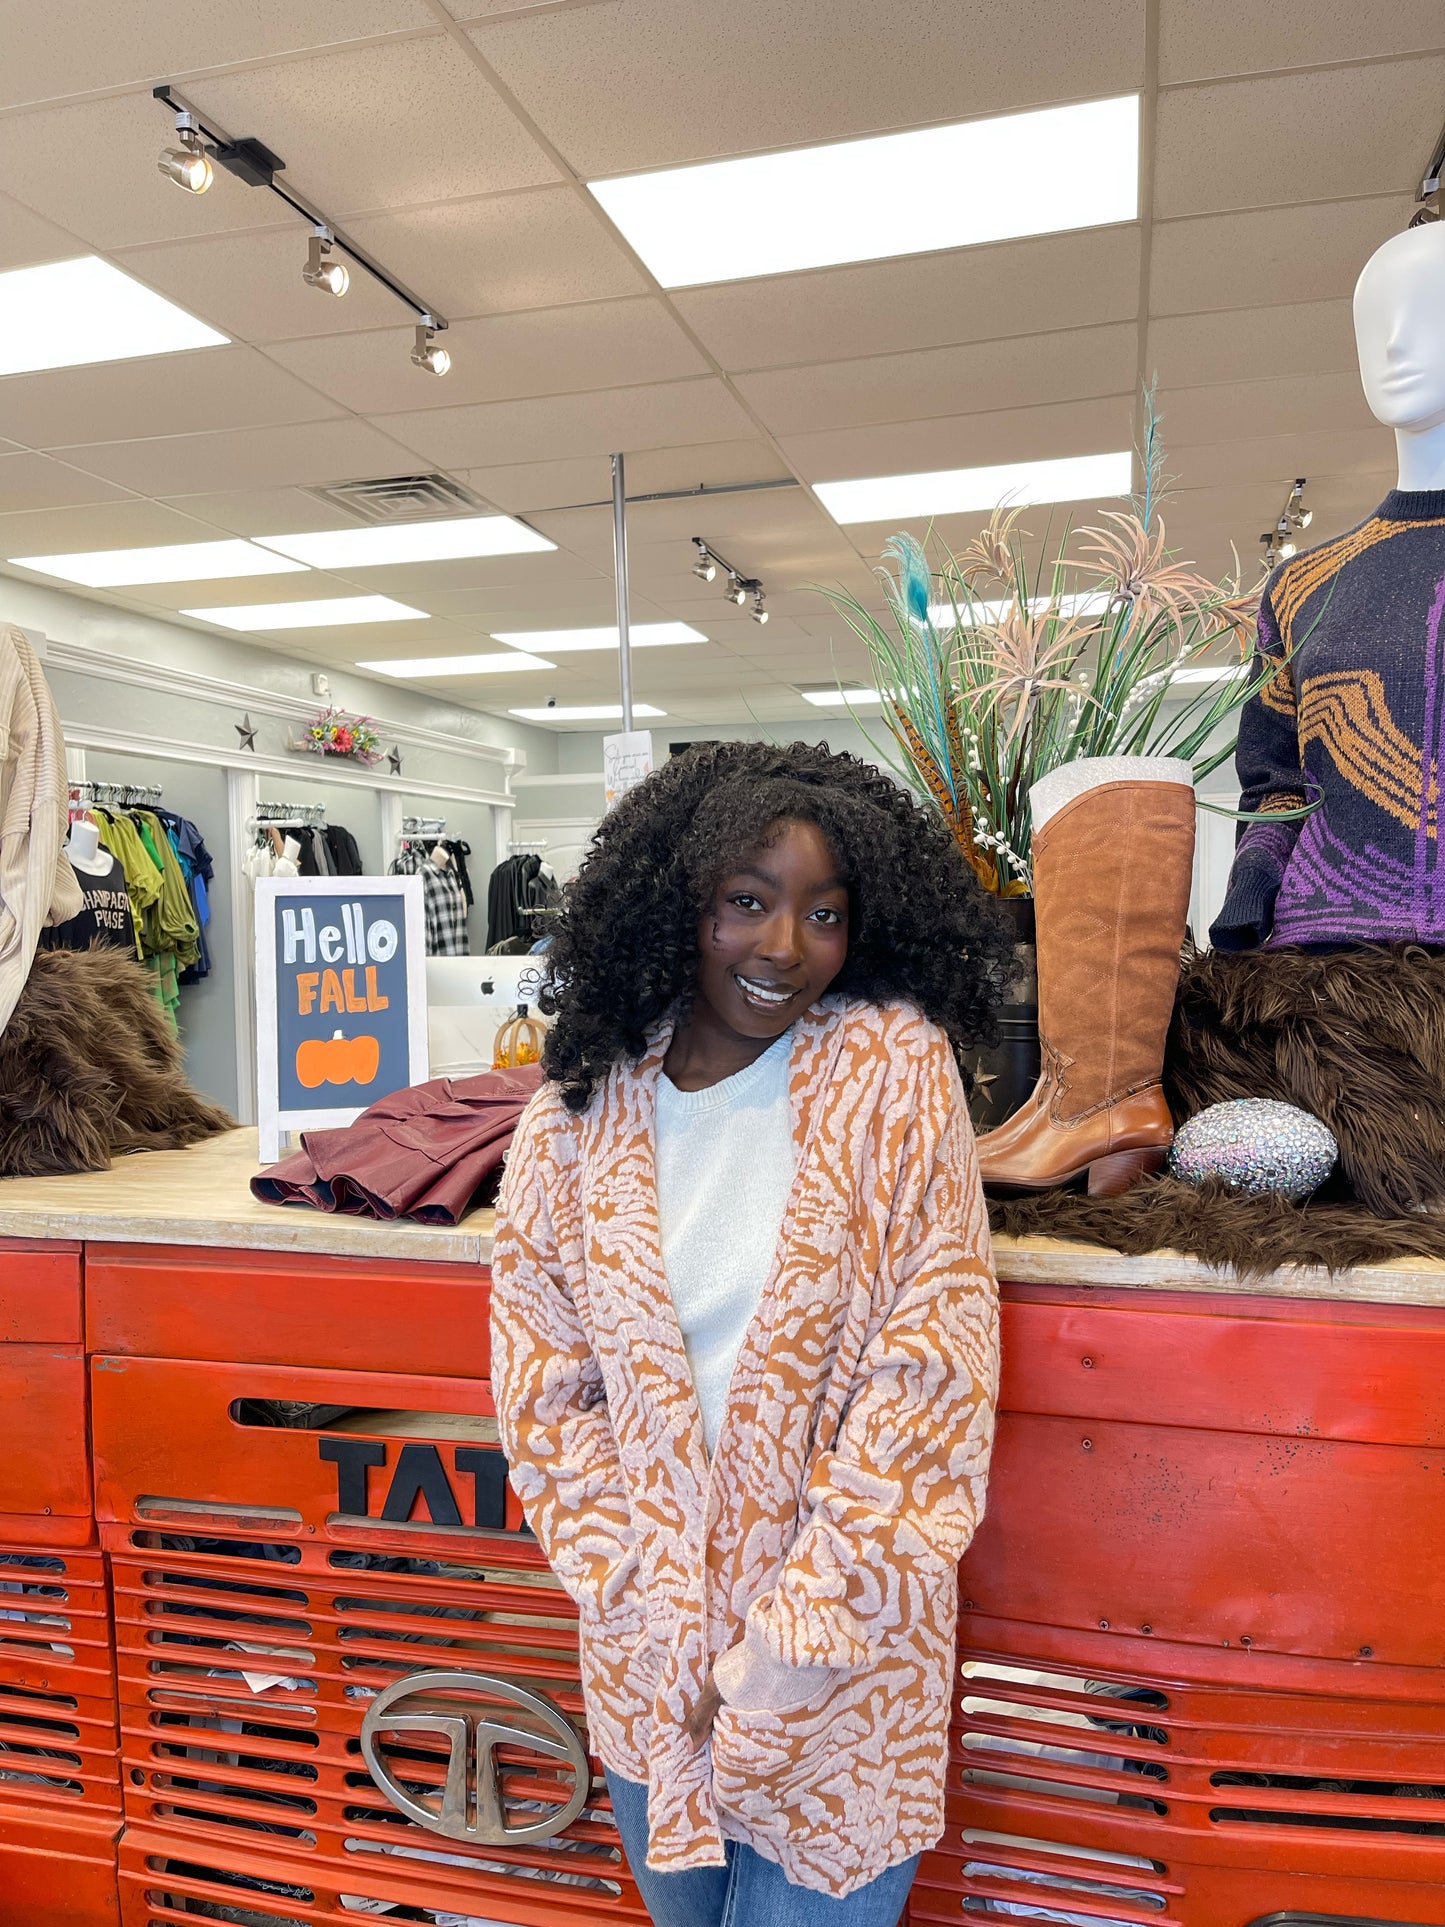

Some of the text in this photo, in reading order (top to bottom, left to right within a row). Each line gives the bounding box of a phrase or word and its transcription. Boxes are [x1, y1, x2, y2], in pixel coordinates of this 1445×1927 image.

[282, 902, 398, 965] Hello
[296, 965, 390, 1016] FALL
[318, 1436, 532, 1533] TAT
